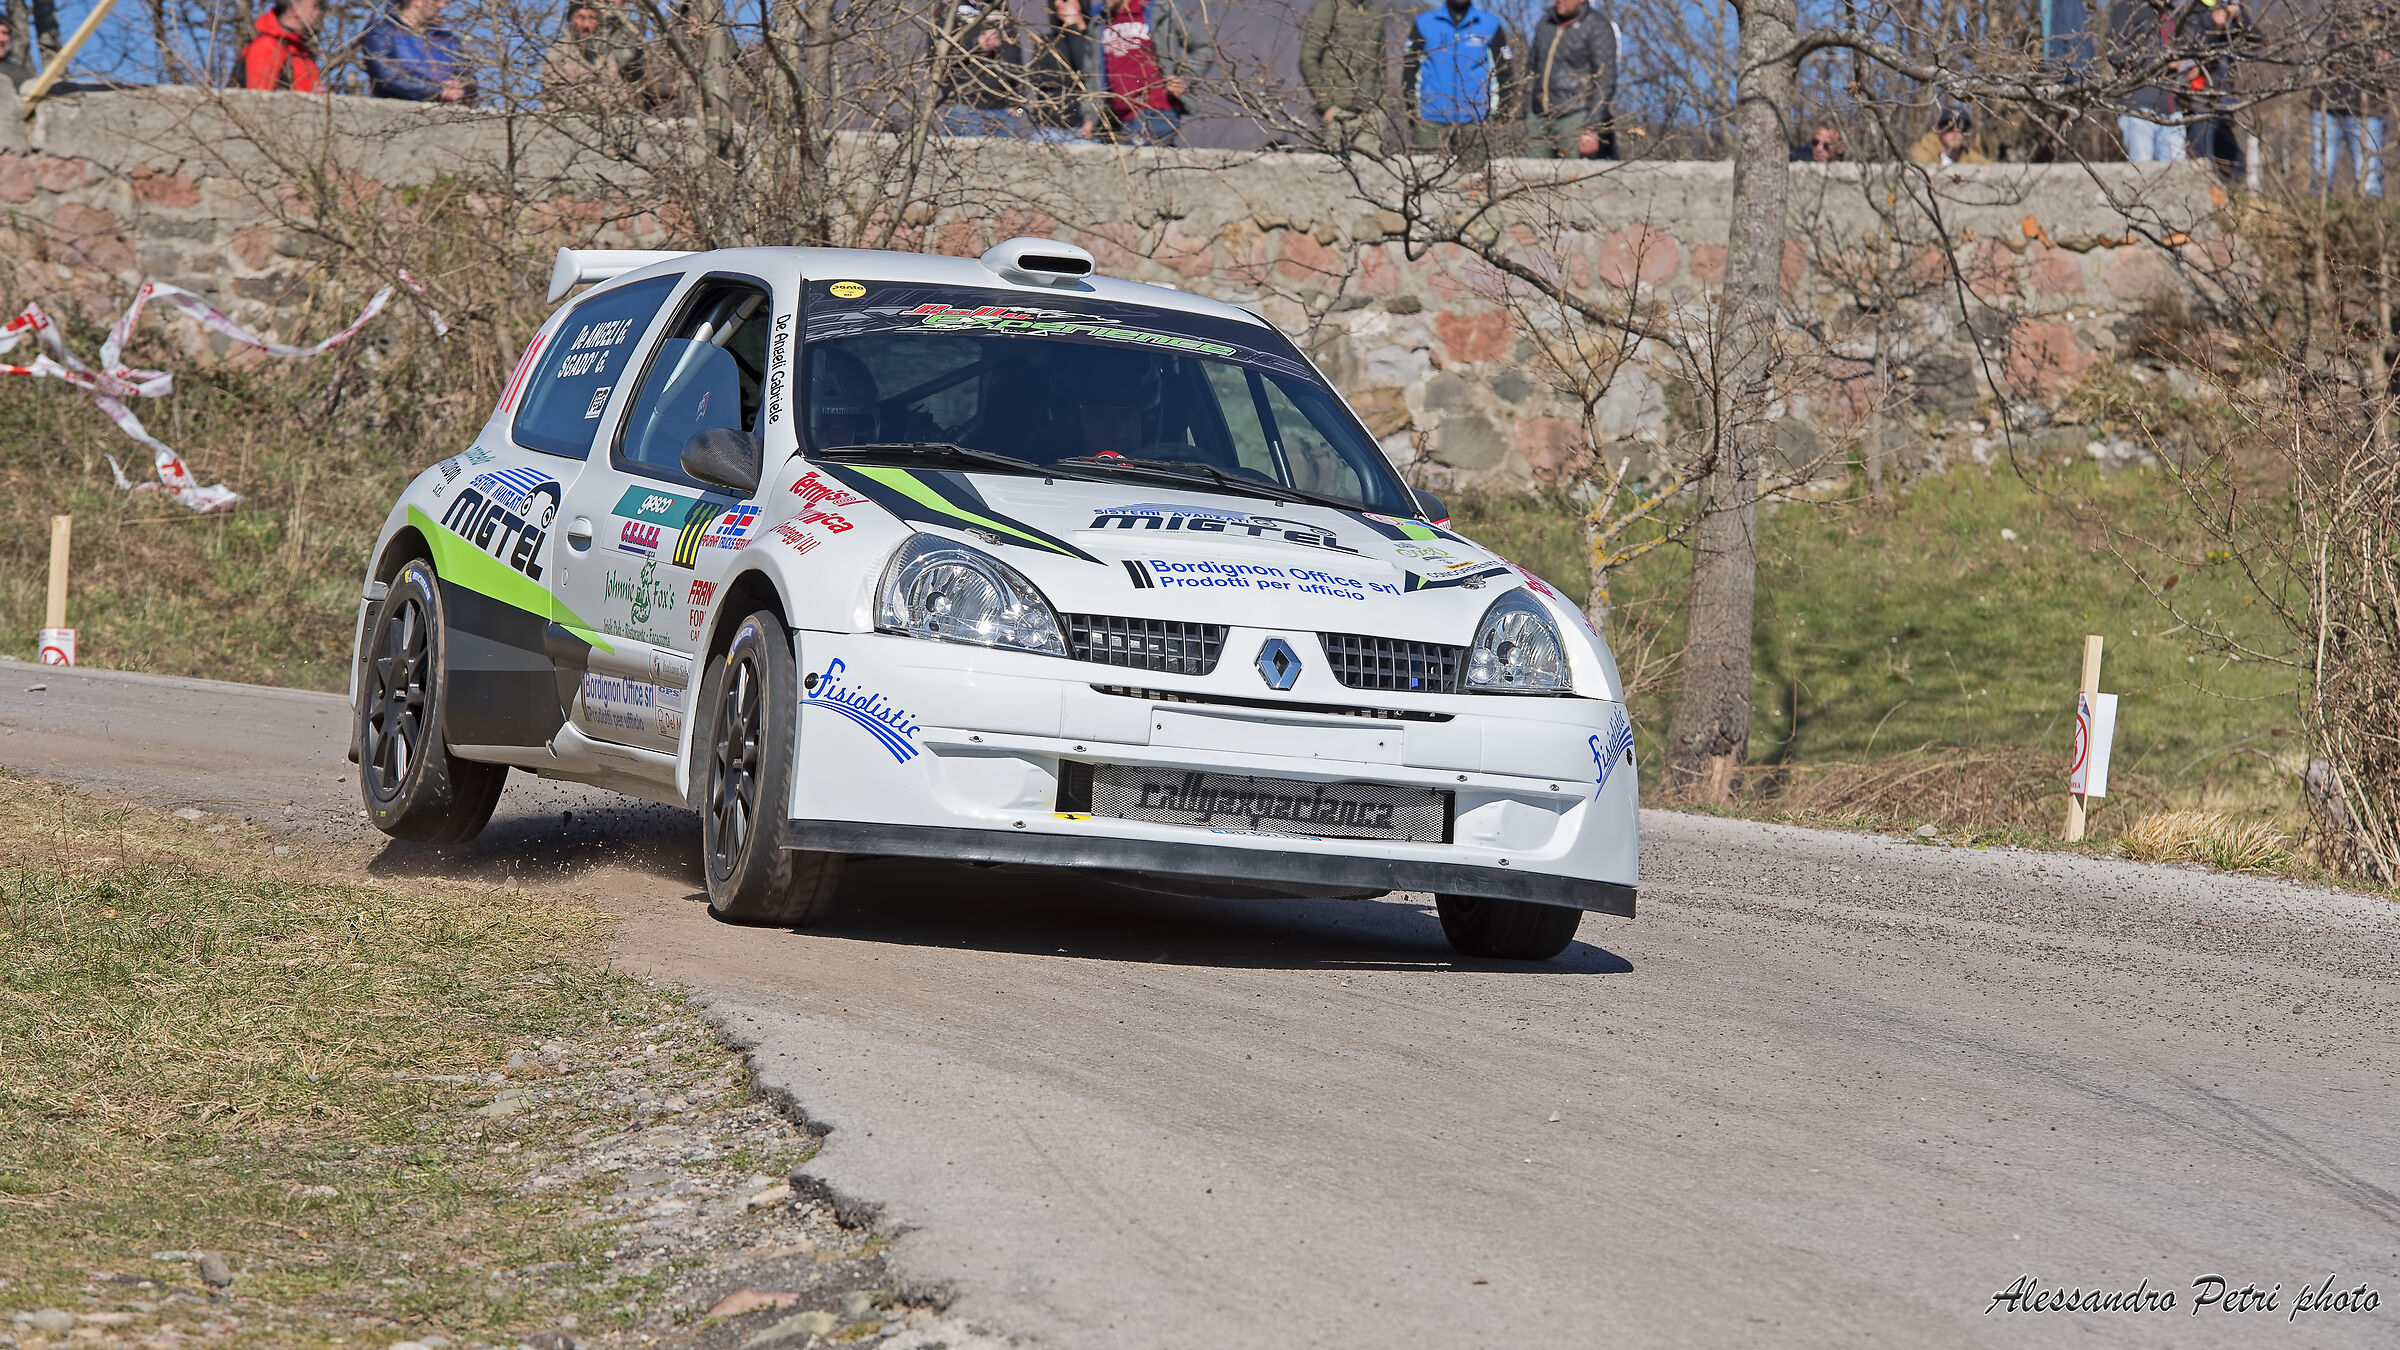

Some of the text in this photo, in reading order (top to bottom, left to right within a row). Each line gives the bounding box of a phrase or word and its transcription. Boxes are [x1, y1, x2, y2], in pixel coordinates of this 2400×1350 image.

[570, 324, 590, 351] De
[582, 319, 626, 349] ANGELI
[768, 313, 791, 425] De Angeli Gabriele
[440, 487, 547, 582] MIGTEL
[674, 502, 721, 566] 111
[1089, 514, 1359, 553] MIGTEL
[1093, 508, 1250, 524] SISTEMI AVANZATI
[603, 569, 675, 611] Johnnie Fox's
[1149, 559, 1401, 597] Bordignon Office Srl
[1159, 576, 1365, 601] Prodotti per ufficio
[585, 671, 655, 708] Bordignon Office srl
